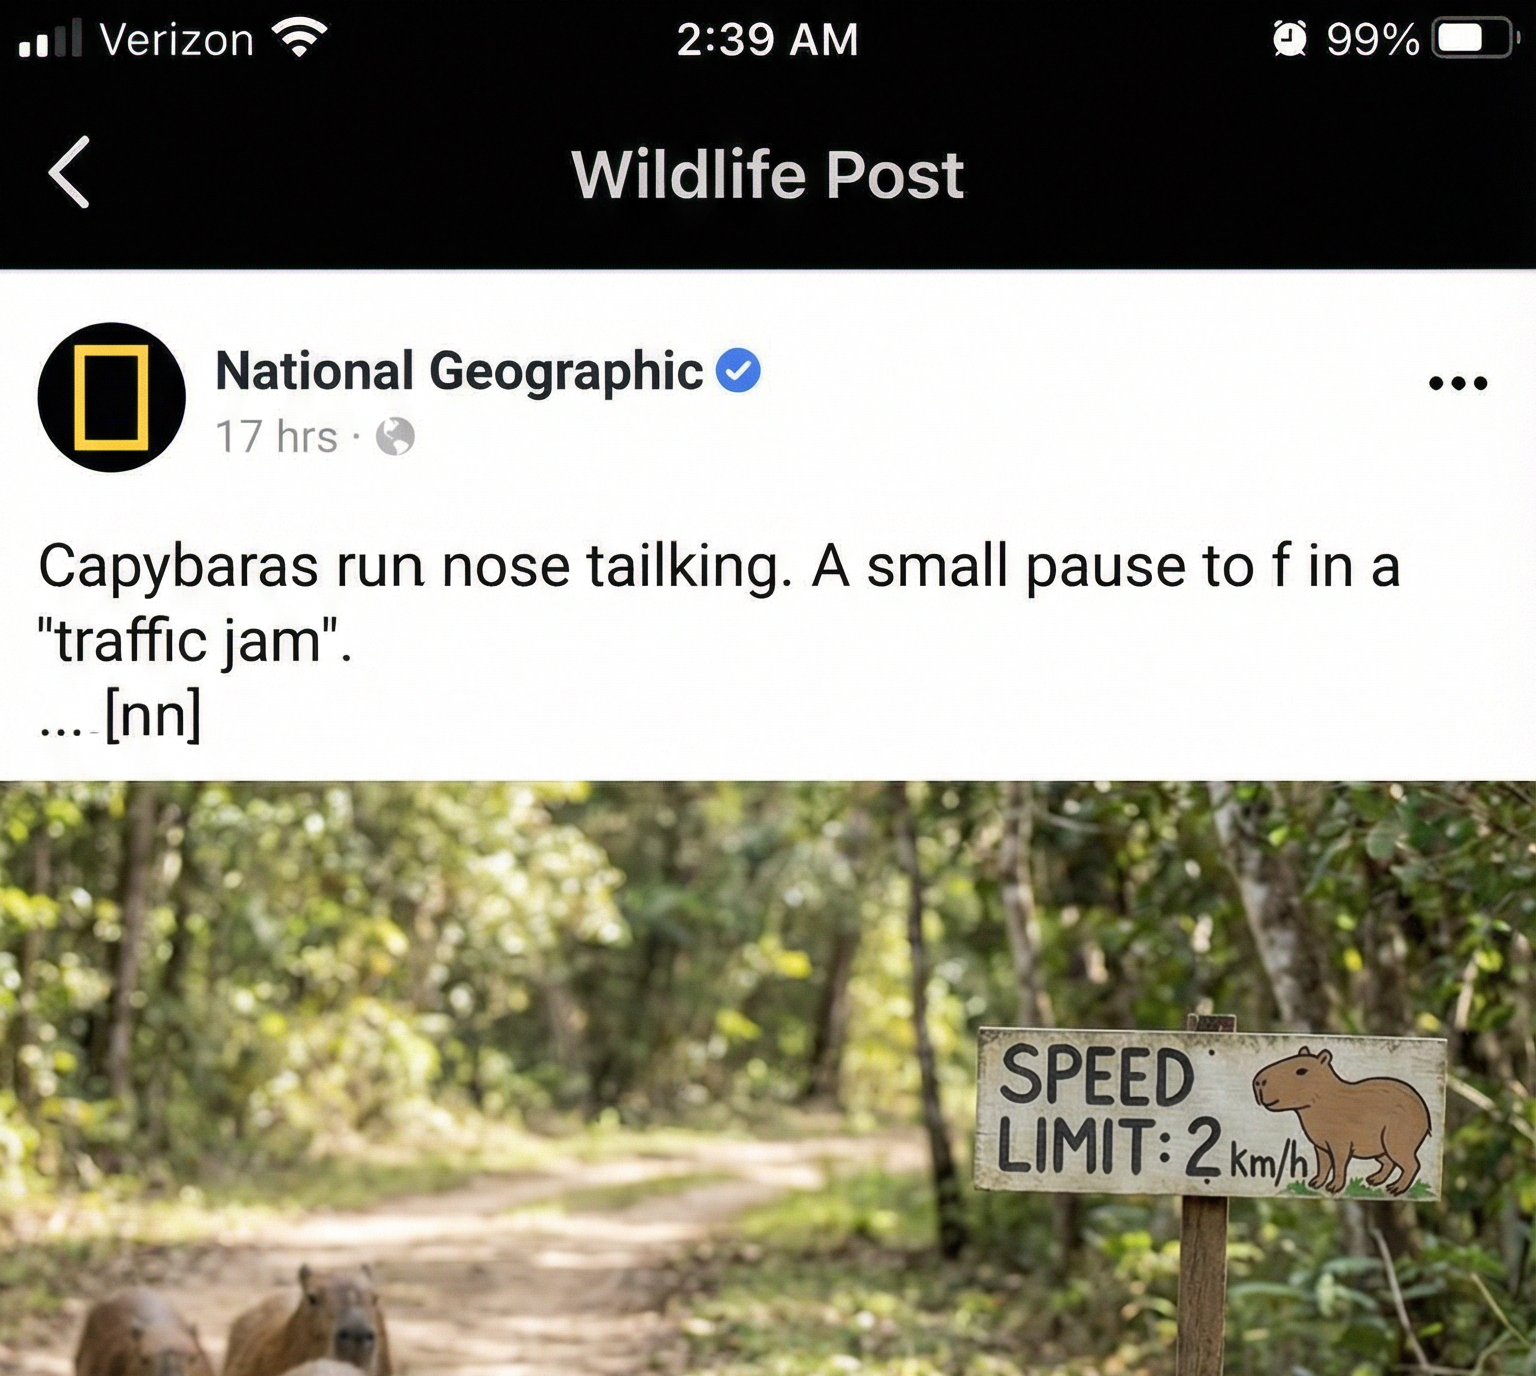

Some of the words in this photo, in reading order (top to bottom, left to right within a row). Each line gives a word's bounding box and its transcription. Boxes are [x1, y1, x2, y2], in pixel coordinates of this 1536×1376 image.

[100, 22, 253, 56] Verizon
[677, 22, 774, 57] 2:39
[789, 22, 859, 56] AM
[1327, 21, 1420, 57] 99%
[571, 147, 805, 200] Wildlife
[828, 150, 965, 200] Post
[216, 349, 412, 391] National
[430, 349, 704, 400] Geographic
[217, 419, 263, 453] 17
[278, 418, 337, 453] hrs
[39, 541, 318, 599] Capybaras
[338, 553, 426, 587] run
[444, 553, 570, 588] nose
[585, 540, 791, 599] tailking.
[811, 542, 851, 587] A
[867, 540, 1006, 588] small
[1028, 553, 1186, 599] pause
[1201, 545, 1254, 588] to
[1271, 539, 1293, 587] f
[1310, 542, 1352, 587] in
[1372, 553, 1400, 588] a
[38, 615, 207, 663] "traffic
[221, 616, 351, 675] jam".
[106, 687, 200, 745] [nn]
[999, 1042, 1195, 1107] SPEED
[999, 1116, 1171, 1175] LIMIT:
[1185, 1116, 1222, 1178] 2
[1230, 1138, 1309, 1187] km/h
